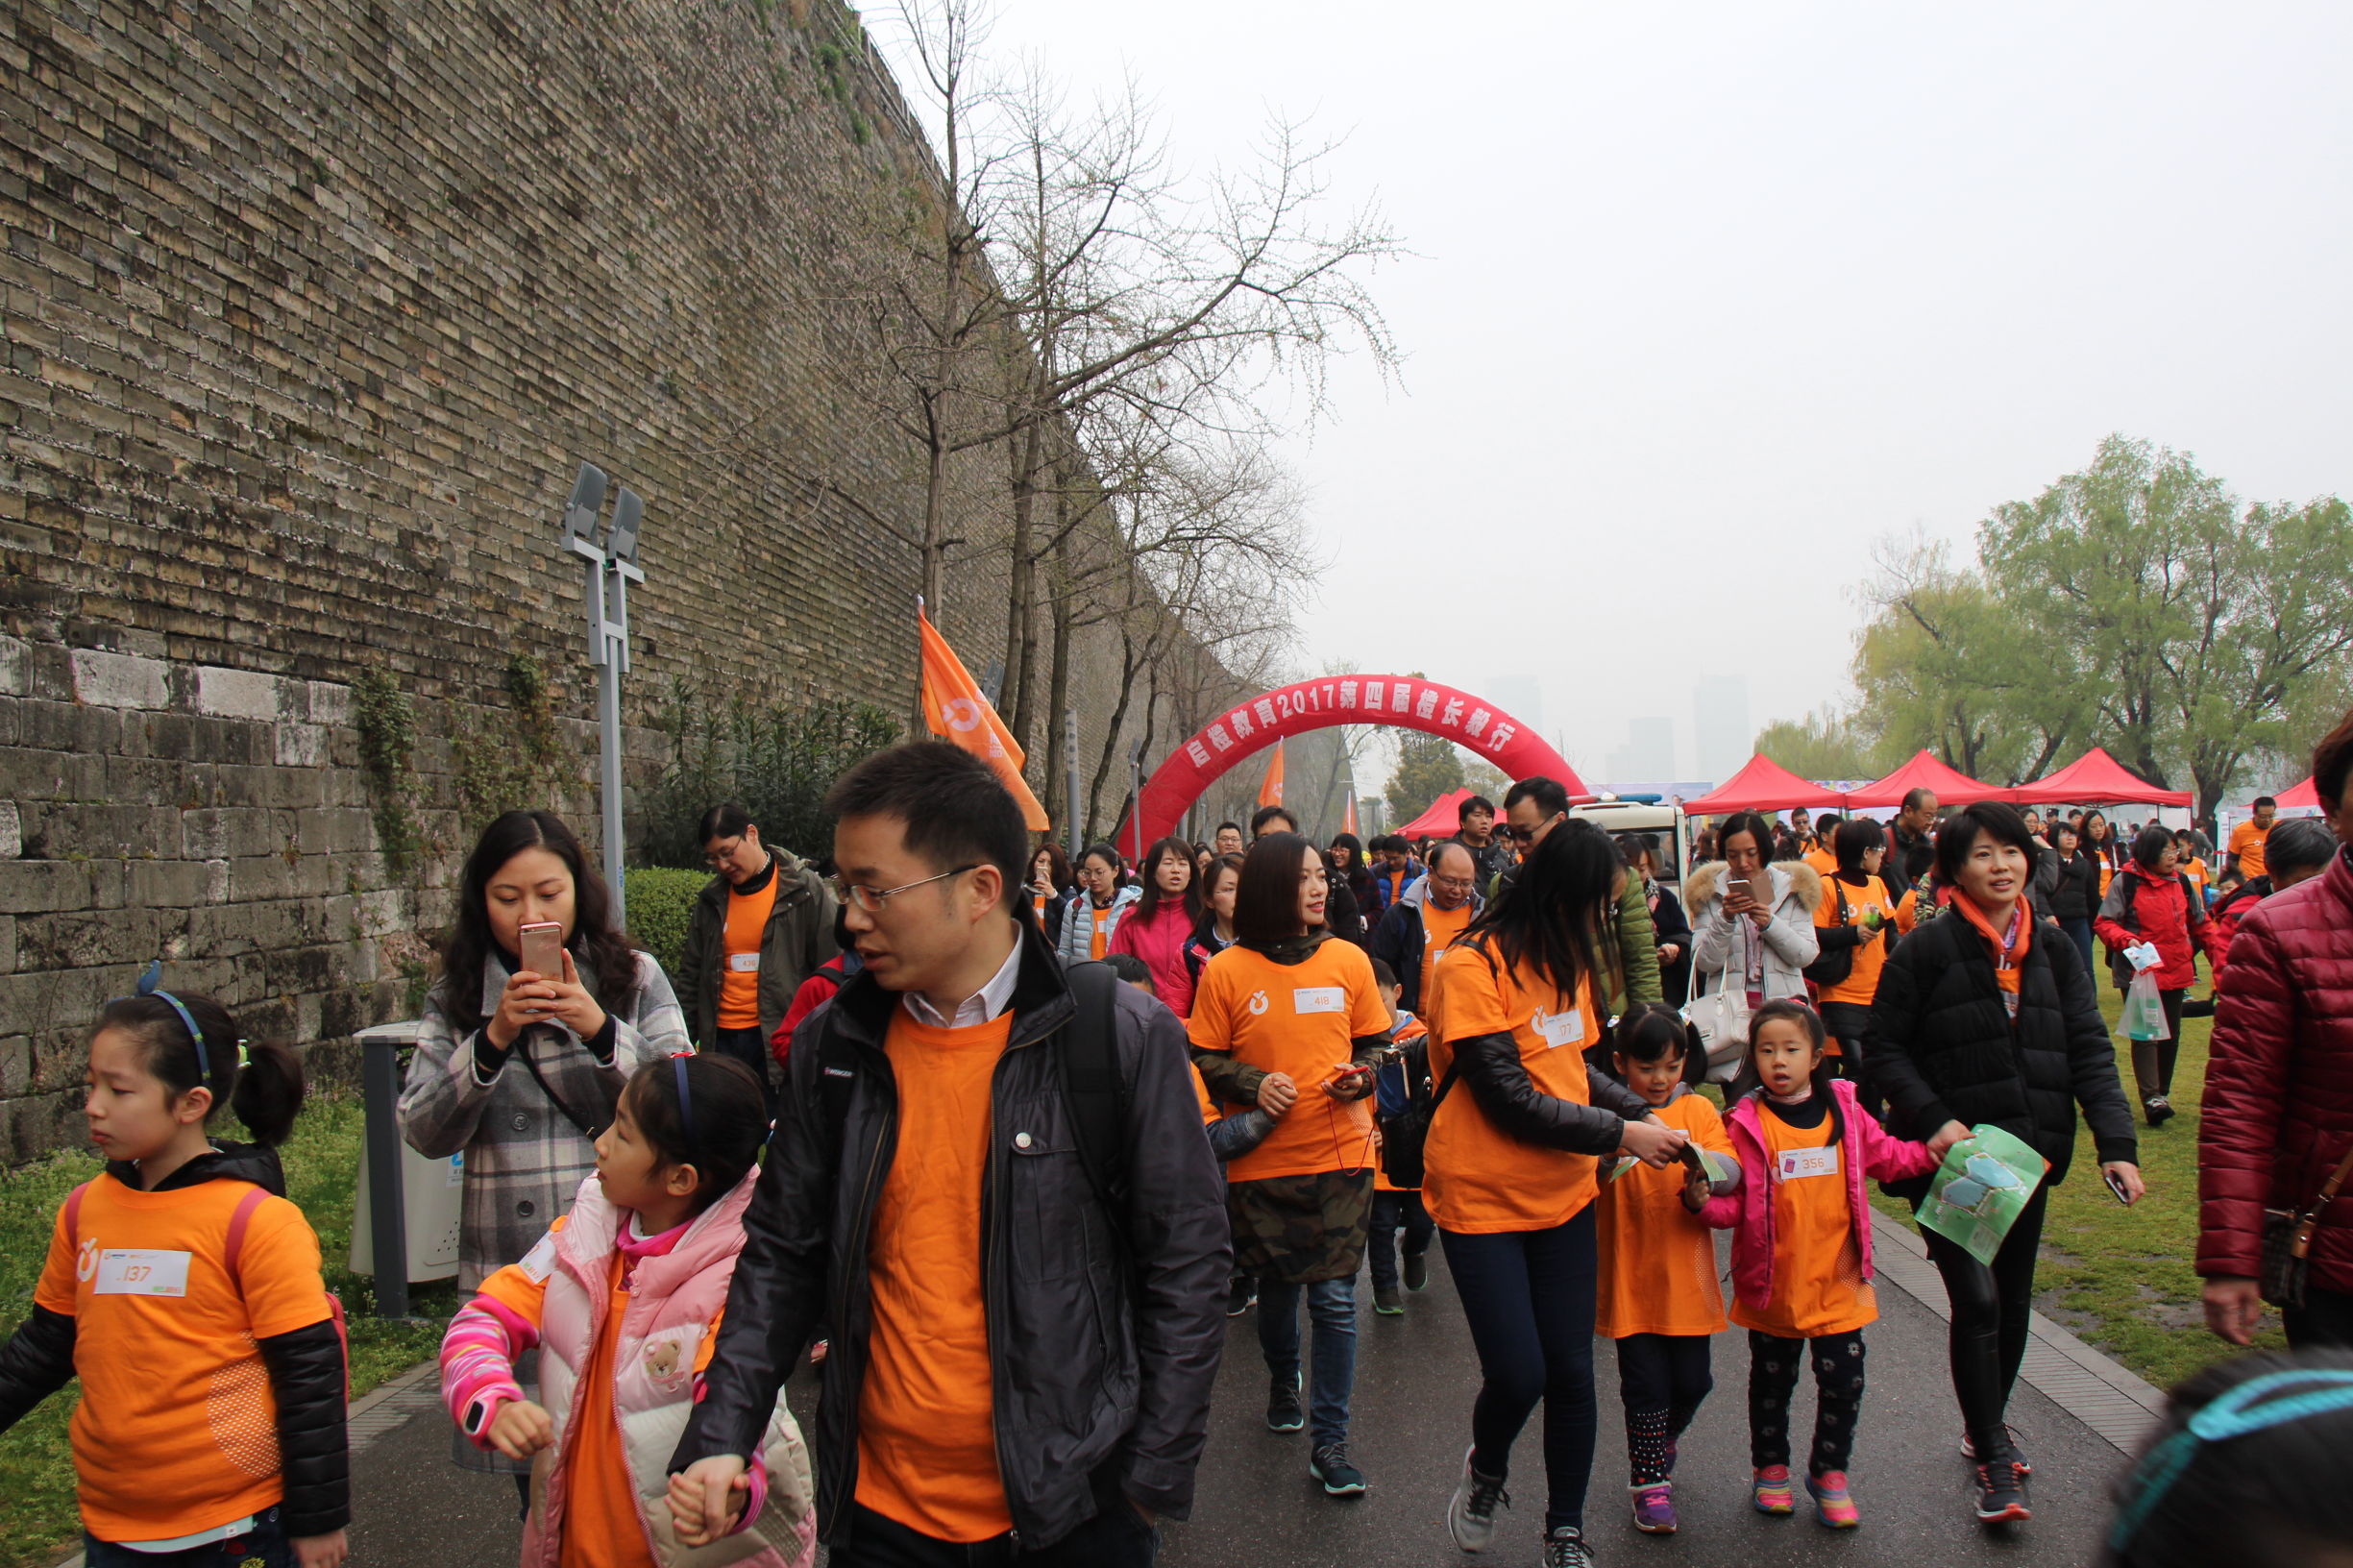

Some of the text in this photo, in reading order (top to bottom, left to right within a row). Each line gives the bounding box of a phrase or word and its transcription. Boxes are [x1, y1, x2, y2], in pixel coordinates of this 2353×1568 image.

[1314, 996, 1330, 1005] 418
[1802, 1157, 1826, 1169] 356
[123, 1265, 152, 1282] 137
